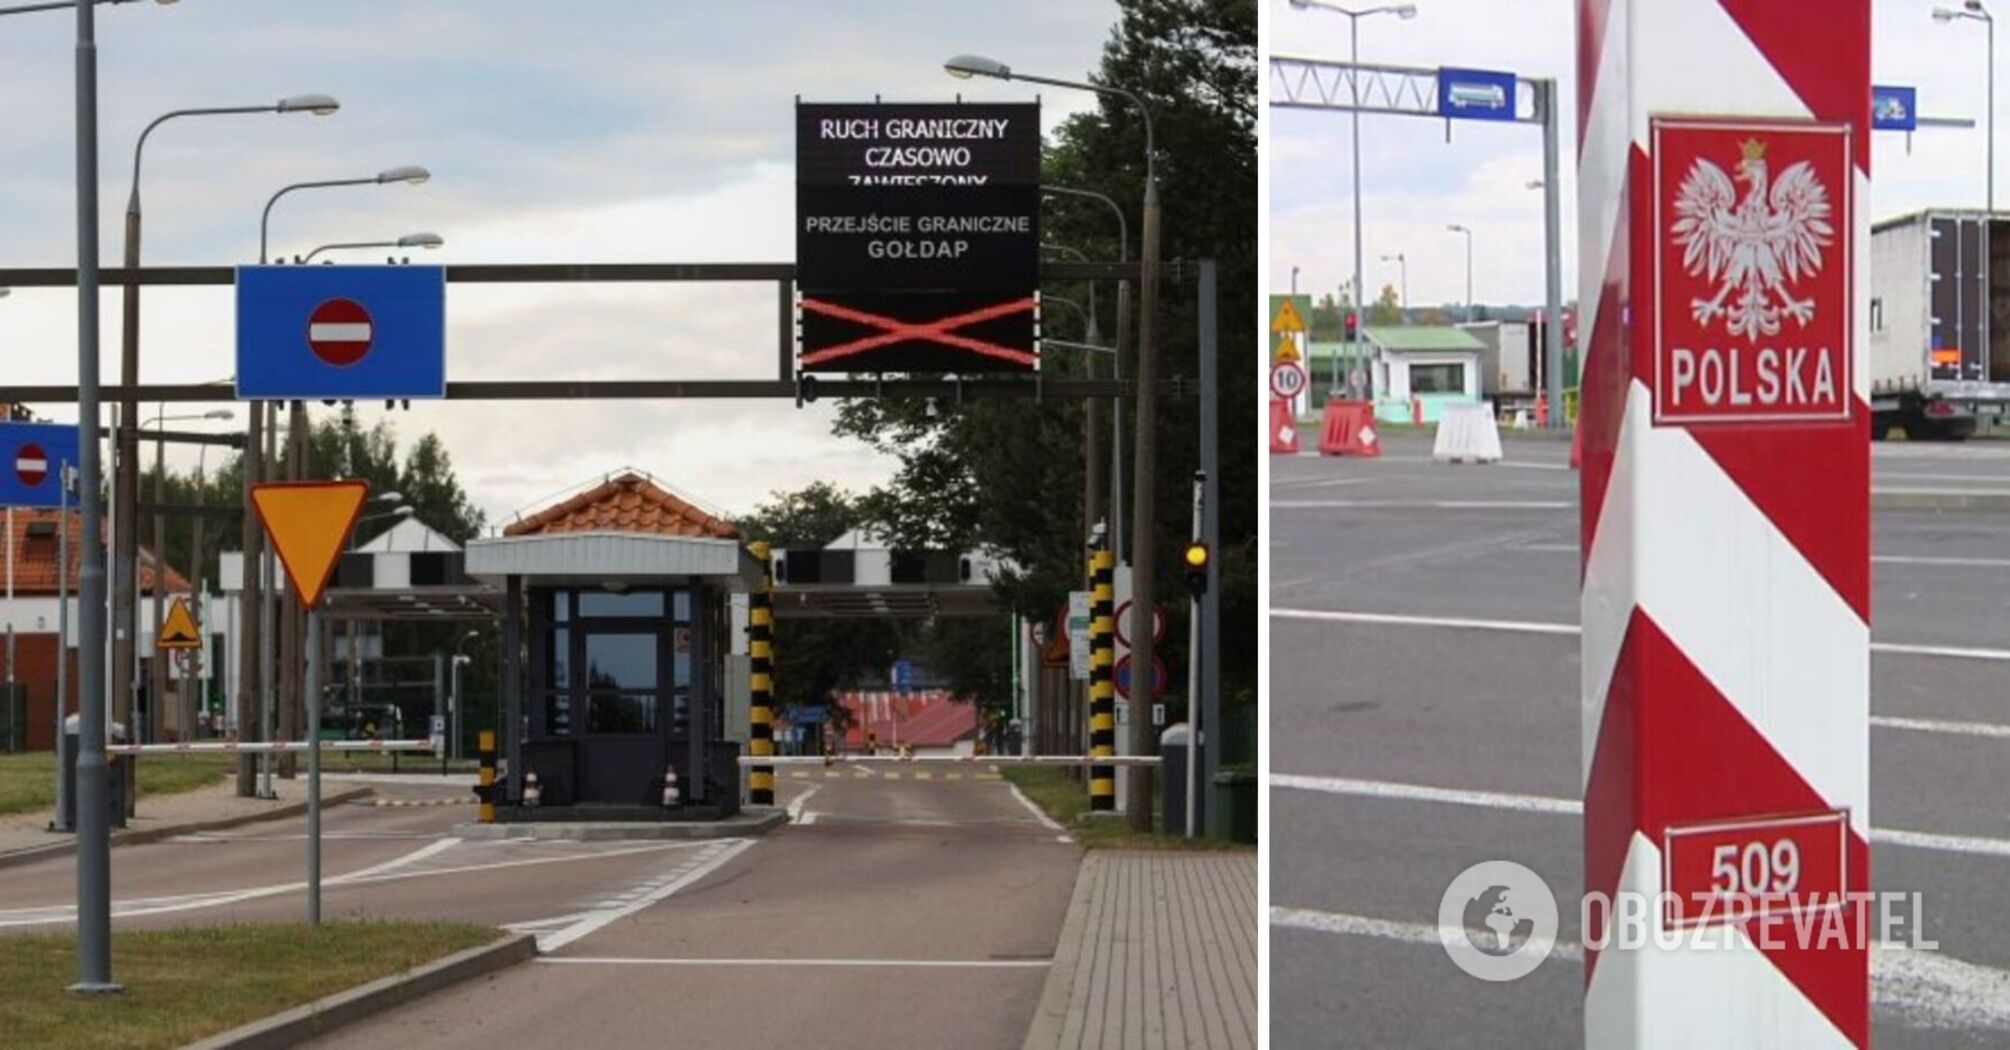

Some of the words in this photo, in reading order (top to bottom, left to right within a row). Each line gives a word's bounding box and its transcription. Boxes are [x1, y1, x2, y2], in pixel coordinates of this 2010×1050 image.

[820, 119, 879, 139] RUCH
[886, 119, 1008, 139] GRANICZNY
[865, 147, 970, 167] CZASOWO
[806, 212, 910, 232] PRZEJŚCIE
[917, 216, 1030, 232] GRANICZNE
[868, 240, 969, 259] GOŁDAP
[1278, 371, 1297, 389] 10
[1672, 348, 1835, 406] POLSKA
[1711, 839, 1800, 900] 509
